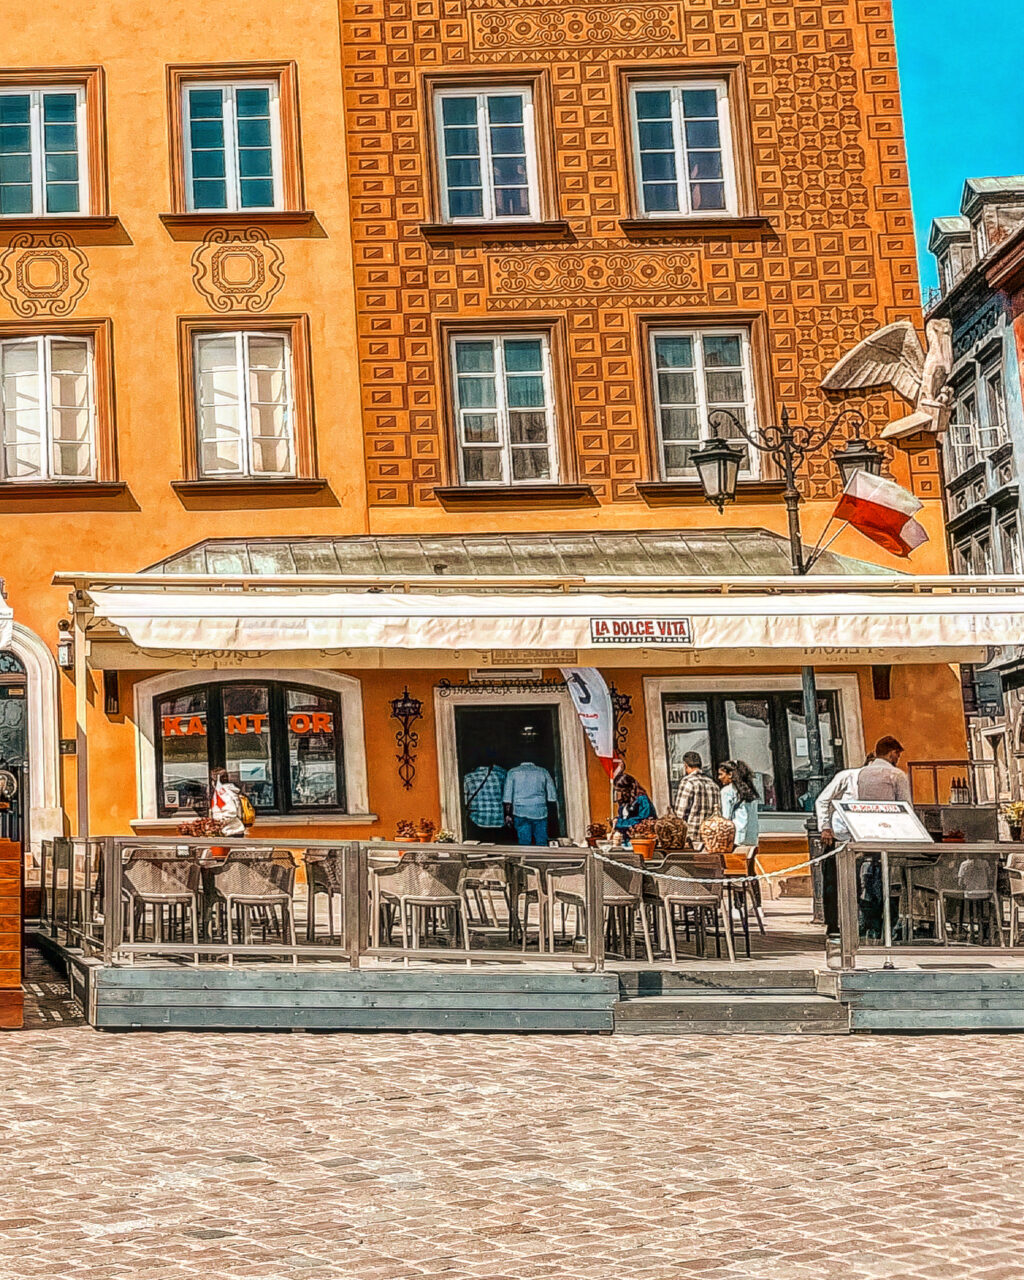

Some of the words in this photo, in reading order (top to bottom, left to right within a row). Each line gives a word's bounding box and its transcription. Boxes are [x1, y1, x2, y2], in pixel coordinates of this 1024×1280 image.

[595, 621, 610, 636] LA
[612, 621, 654, 636] DOLCE
[656, 621, 686, 636] VITA
[668, 710, 706, 723] ANTOR
